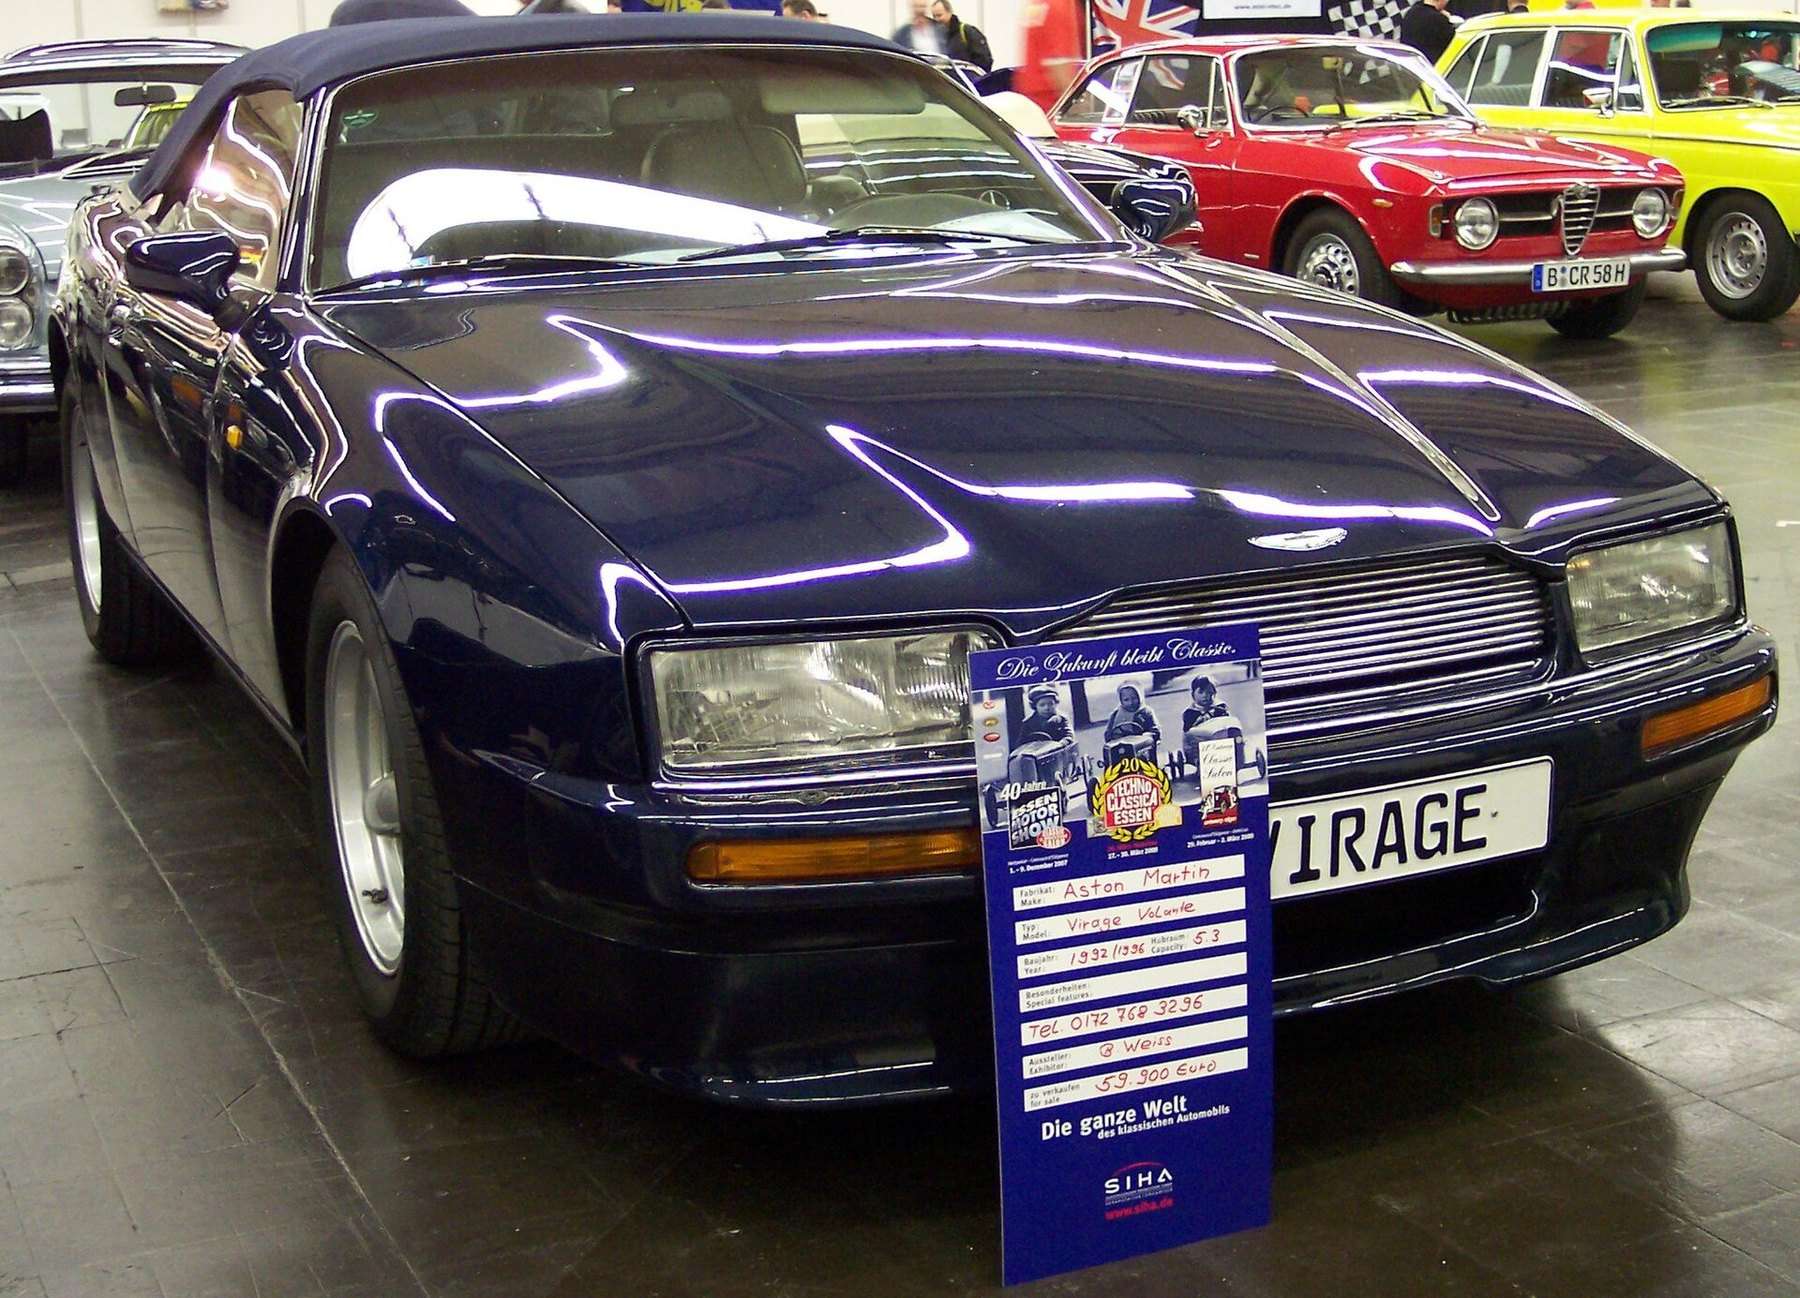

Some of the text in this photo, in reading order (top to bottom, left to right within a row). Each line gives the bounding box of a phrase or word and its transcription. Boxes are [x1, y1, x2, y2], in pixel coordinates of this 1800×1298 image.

[1547, 263, 1626, 287] B CR 58 H
[995, 638, 1237, 682] Die Zukunft bleibt Classic.
[1121, 758, 1140, 773] 20
[1000, 782, 1022, 801] 40
[1106, 786, 1158, 812] CLASSICA
[1112, 777, 1152, 798] TECHNO
[1011, 791, 1059, 820] ESSEN
[1012, 802, 1060, 832] MOTOR
[1113, 808, 1153, 825] ESSEN
[1011, 815, 1061, 846] SHOW
[1064, 865, 1210, 899] Aston Martin
[1067, 916, 1122, 933] Virage
[1026, 998, 1056, 1009] Special
[1070, 1012, 1109, 1031] 0172
[1116, 1004, 1148, 1022] 768
[1153, 994, 1204, 1016] 3296
[1123, 1035, 1172, 1053] Weiss
[1176, 1059, 1217, 1076] Euro
[1041, 1094, 1188, 1141] Die ganze Welt
[1097, 1104, 1231, 1140] des klassischen Automobils
[1104, 1167, 1173, 1194] SIHA
